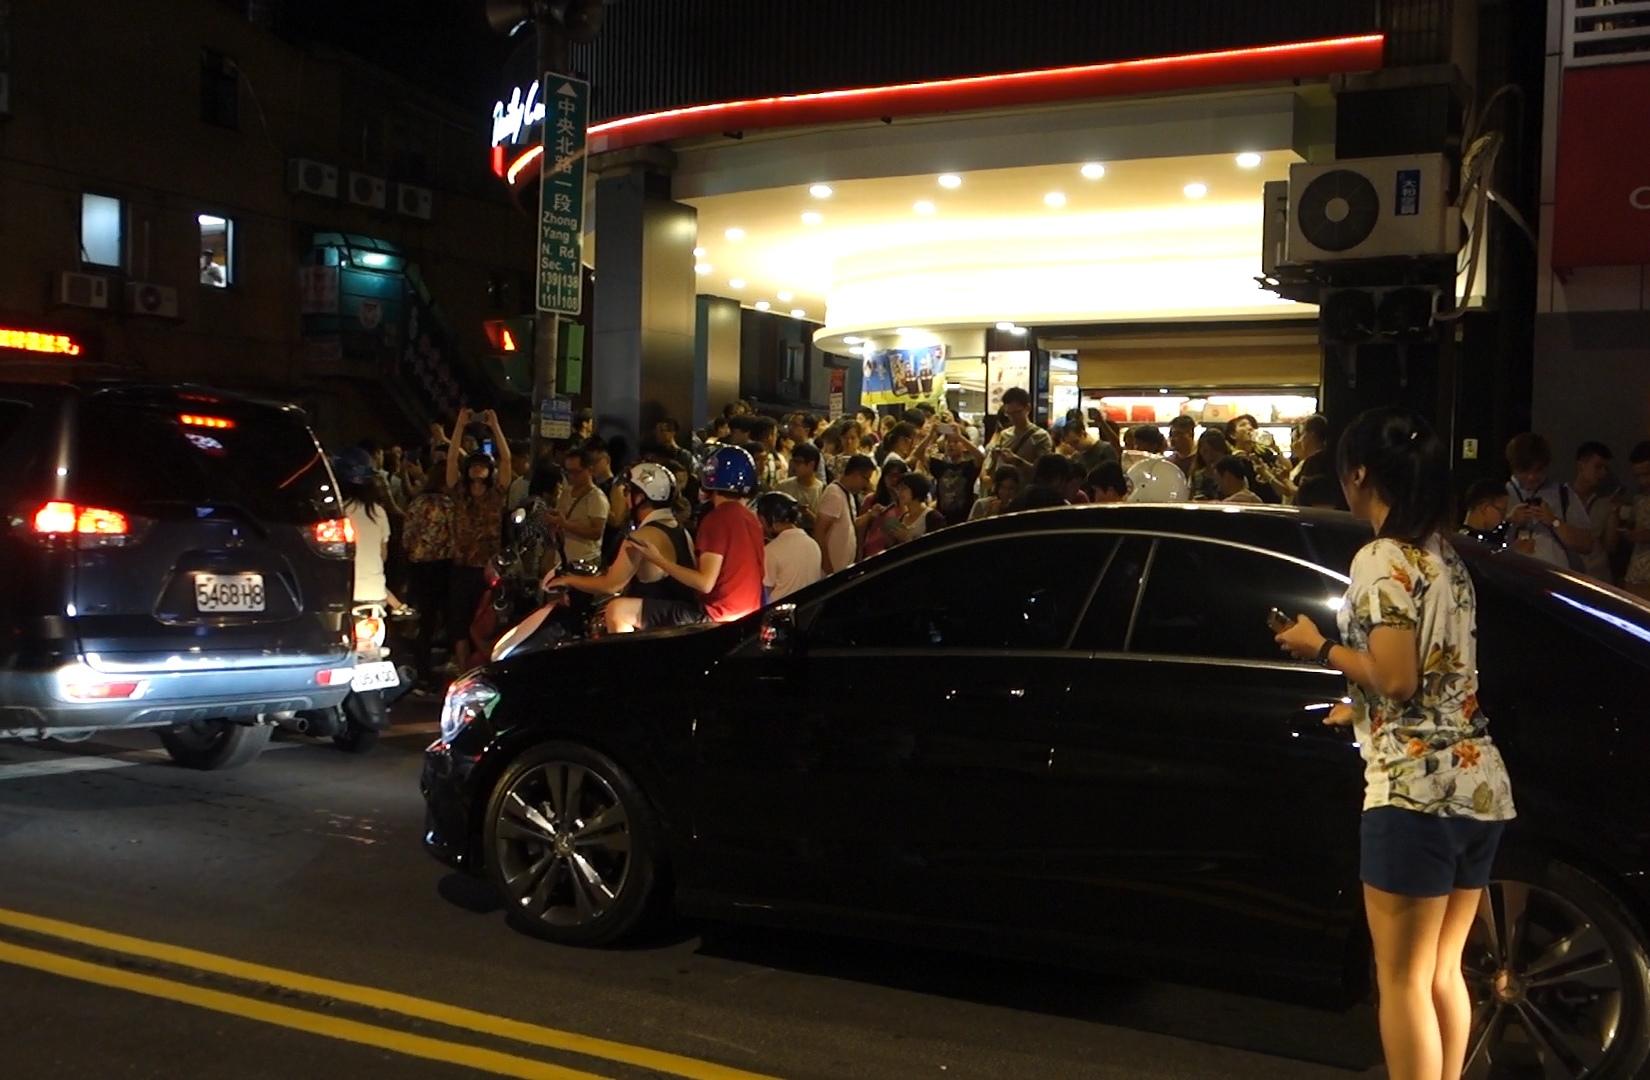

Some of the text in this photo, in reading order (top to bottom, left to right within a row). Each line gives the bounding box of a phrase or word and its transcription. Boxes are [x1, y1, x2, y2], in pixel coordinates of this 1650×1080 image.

[553, 97, 576, 213] 中央北路一段
[543, 210, 578, 231] Zhong
[542, 226, 571, 244] Yang
[559, 246, 578, 260] Rd.
[541, 257, 577, 273] Sec. 1
[541, 293, 557, 308] 111
